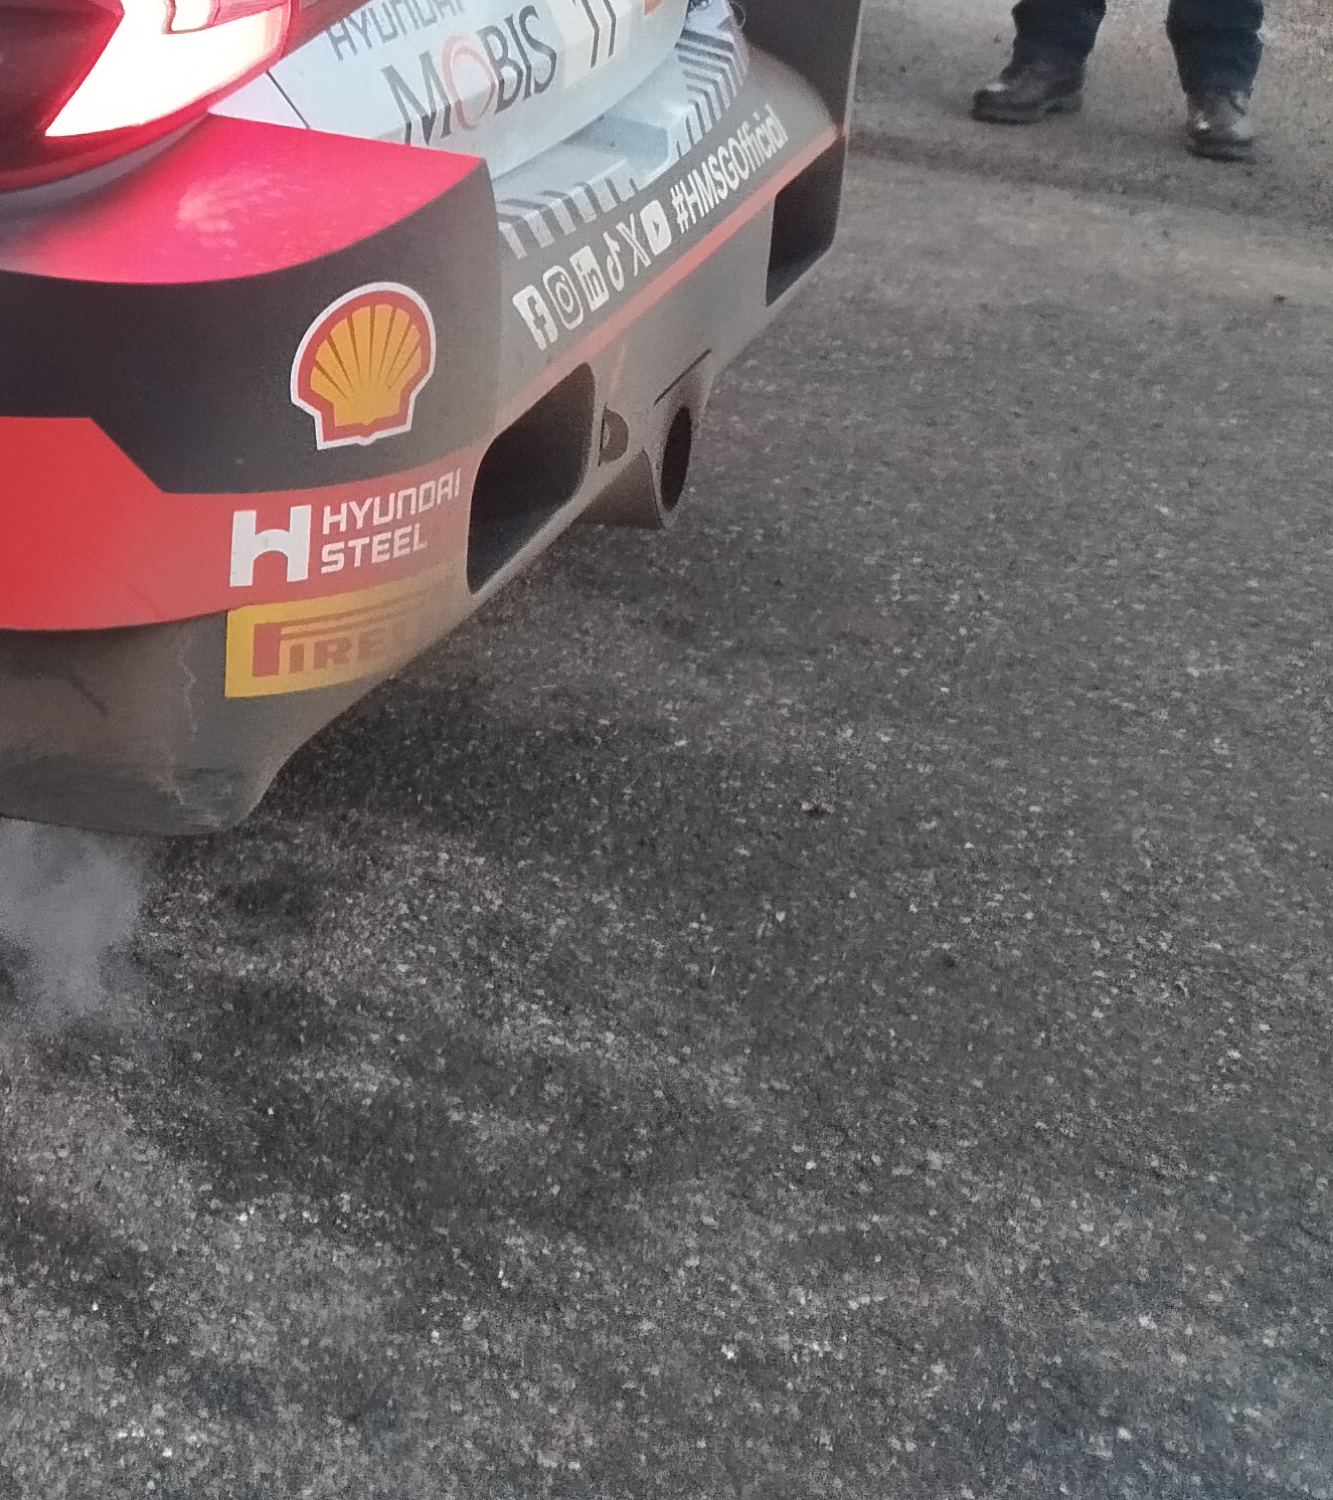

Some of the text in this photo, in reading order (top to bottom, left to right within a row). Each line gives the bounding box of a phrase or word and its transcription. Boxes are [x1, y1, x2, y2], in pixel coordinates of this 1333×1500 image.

[381, 4, 560, 145] MOBIS
[670, 104, 790, 234] #HMSGOfficial
[321, 523, 427, 574] STEEL
[322, 468, 461, 534] HYUNDAI
